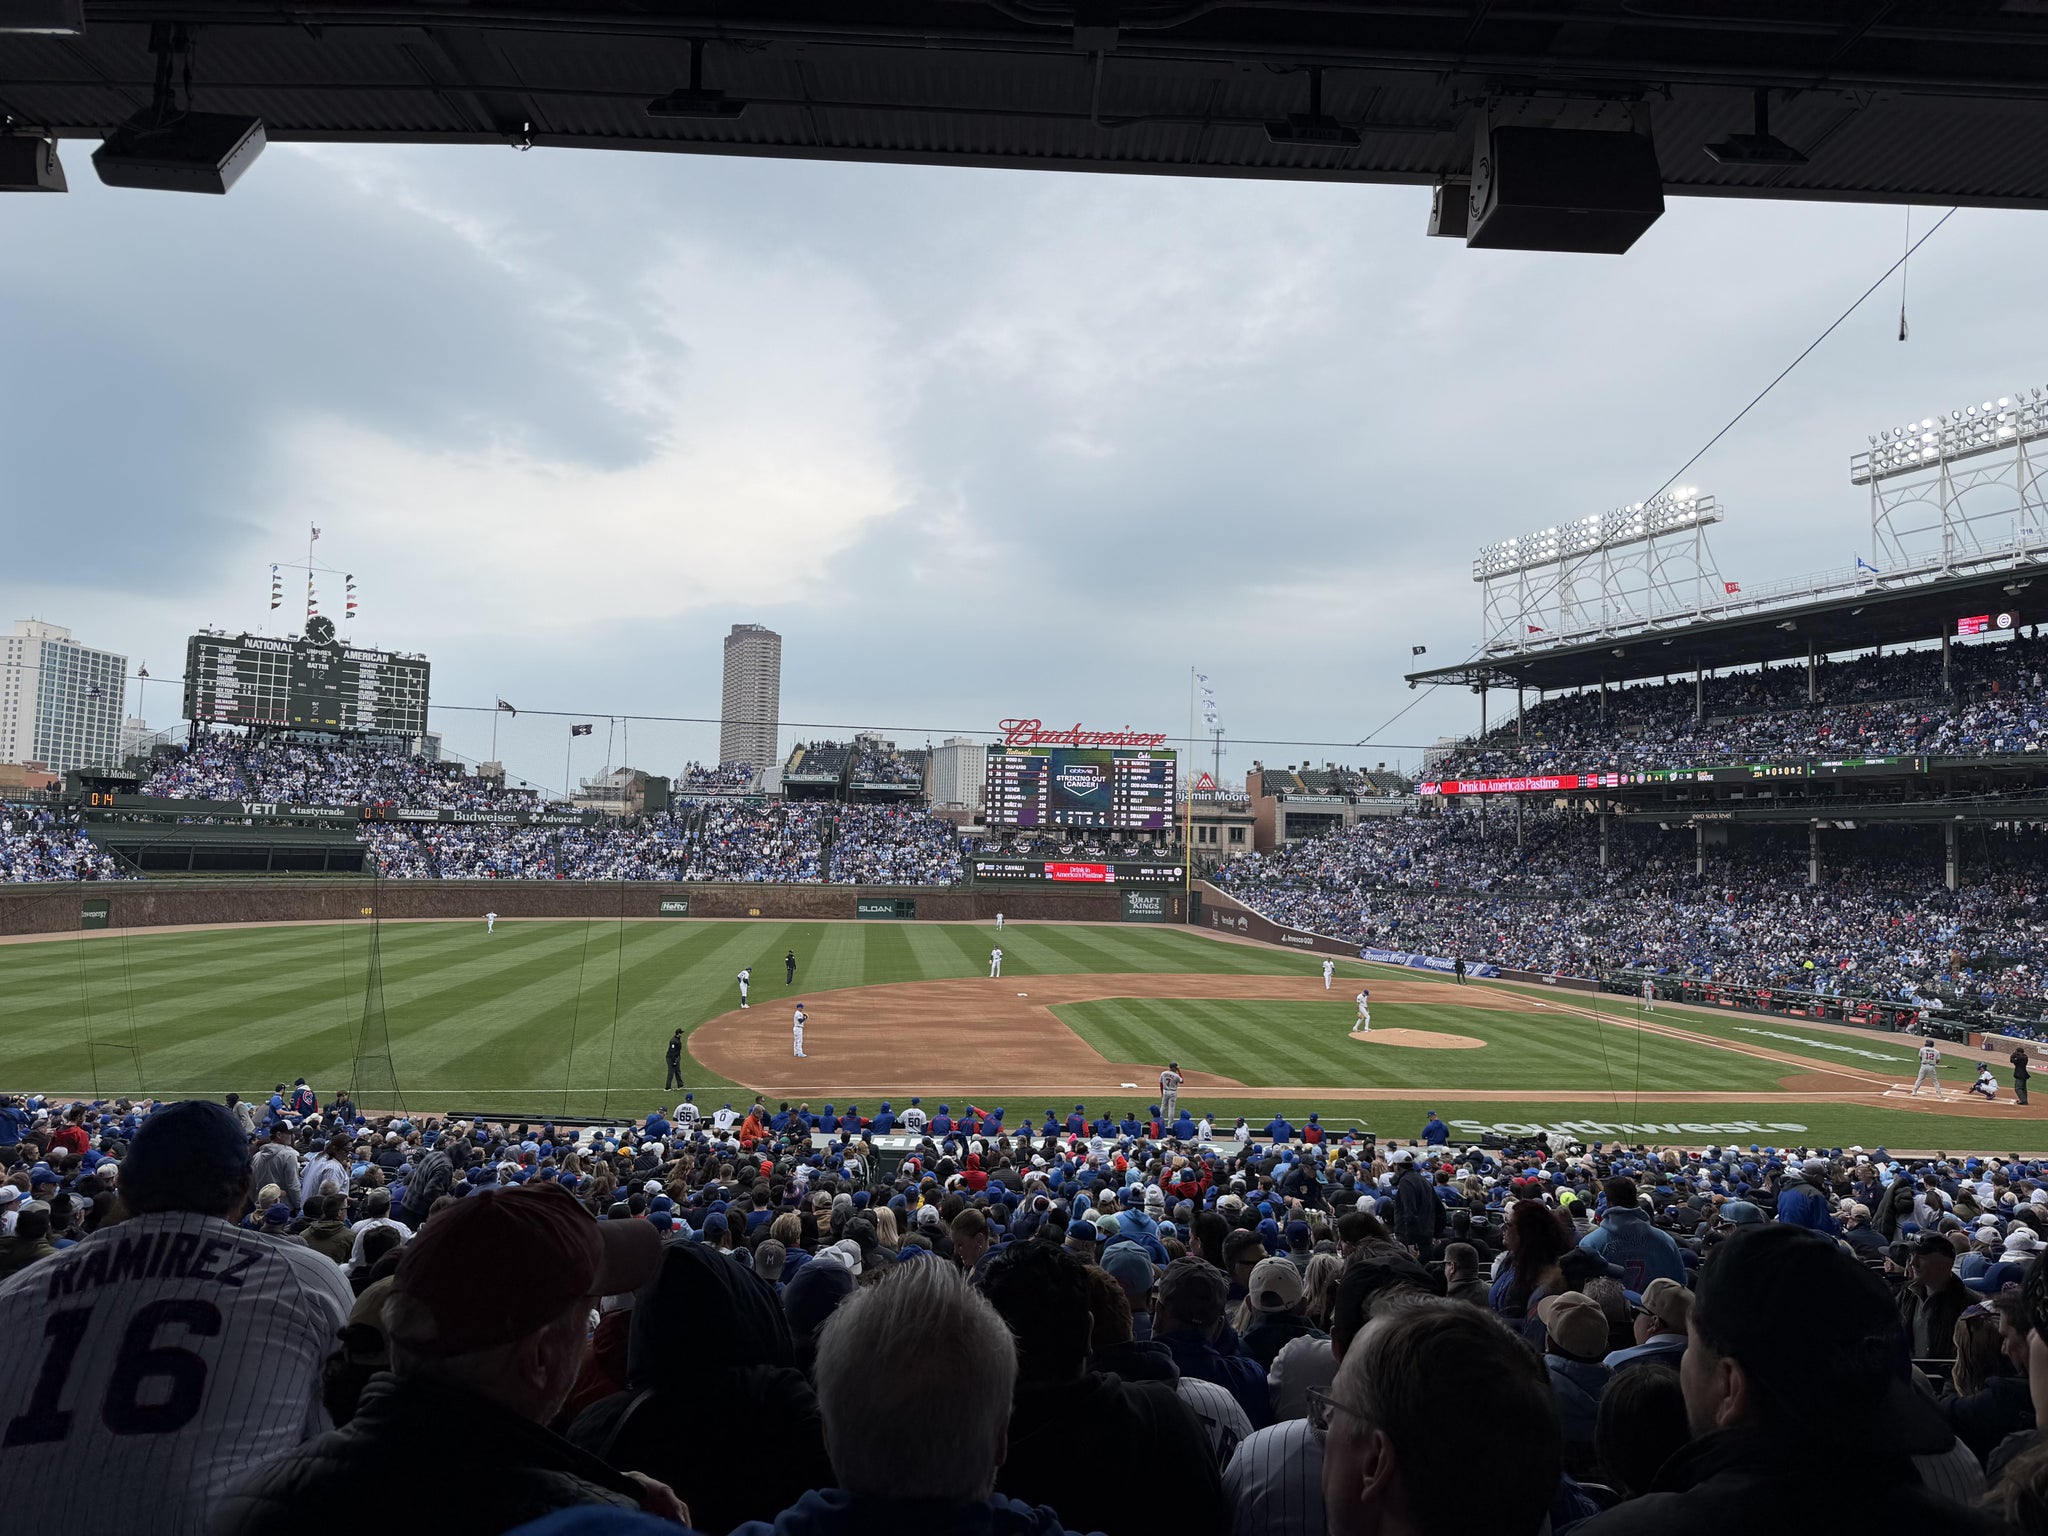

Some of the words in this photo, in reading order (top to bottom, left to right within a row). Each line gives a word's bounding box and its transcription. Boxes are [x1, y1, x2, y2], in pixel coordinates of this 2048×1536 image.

[244, 638, 294, 652] NATIONAL
[343, 650, 389, 663] AMERICAN
[312, 670, 325, 680] 12
[312, 706, 318, 715] 2
[999, 718, 1167, 746] Budweiser
[110, 769, 137, 780] Mobile
[1796, 766, 1802, 775] 2
[1458, 781, 1480, 793] Drink
[1480, 781, 1488, 792] in
[1487, 778, 1526, 791] America's
[1526, 777, 1560, 790] Pastime
[91, 793, 114, 806] 0:14
[1176, 790, 1211, 802] njamin
[1214, 791, 1250, 802] Moore
[241, 803, 278, 815] YETI
[296, 806, 345, 817] tastytrade
[397, 808, 440, 817] GRAINGER
[540, 815, 582, 824] Advocate
[1129, 896, 1160, 904] DRAFT
[660, 901, 687, 911] Hefty
[81, 910, 107, 919] Invenergy
[1287, 935, 1304, 944] Invesco
[1363, 951, 1391, 962] Reynolds
[1390, 953, 1406, 964] Wrap
[1166, 1078, 1171, 1087] 7
[679, 1112, 692, 1121] 65
[719, 1113, 726, 1122] 0
[908, 1118, 920, 1127] 50
[1449, 1119, 1775, 1135] Southwest
[47, 1231, 266, 1300] RAMIREZ
[1625, 1259, 1646, 1291] 7
[2, 1299, 223, 1448] 16
